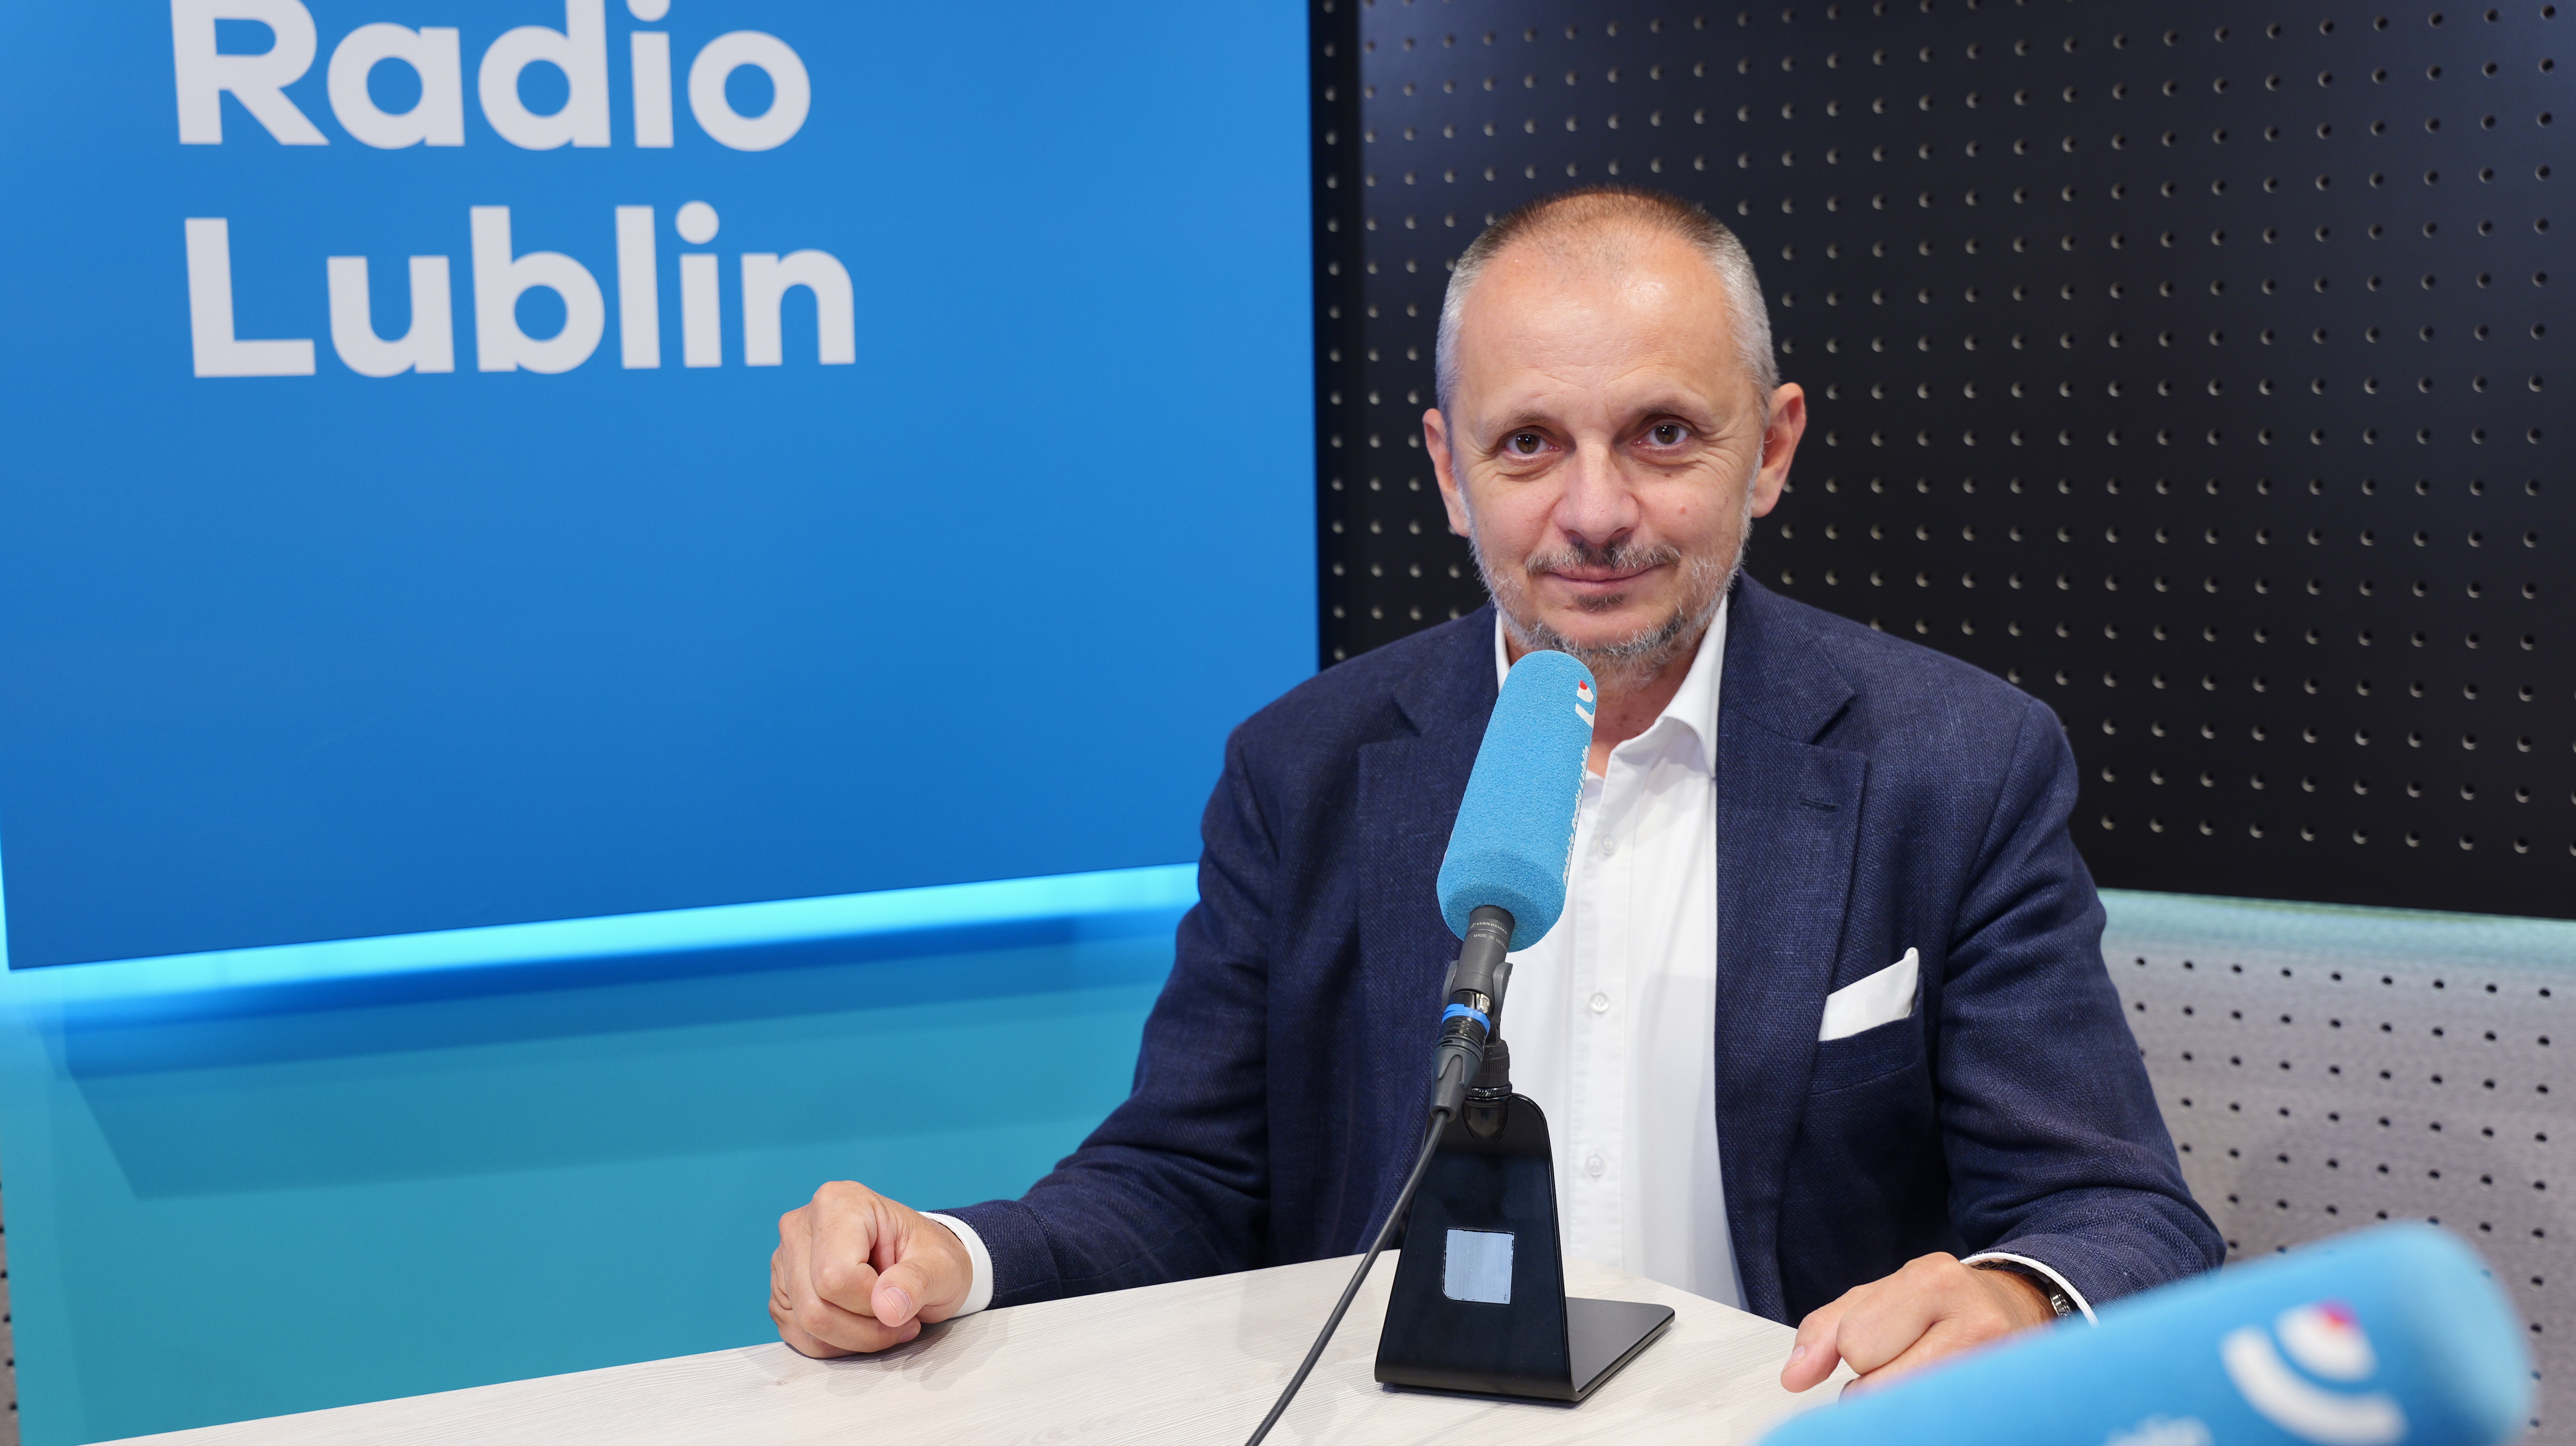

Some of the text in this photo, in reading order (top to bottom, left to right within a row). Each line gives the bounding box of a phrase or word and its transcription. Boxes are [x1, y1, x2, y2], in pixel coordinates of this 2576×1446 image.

[170, 0, 811, 152] Radio
[184, 200, 856, 378] Lublin
[1571, 789, 1583, 833] Radio
[1579, 745, 1589, 790] Lublin
[1476, 921, 1507, 935] SENNHEISER
